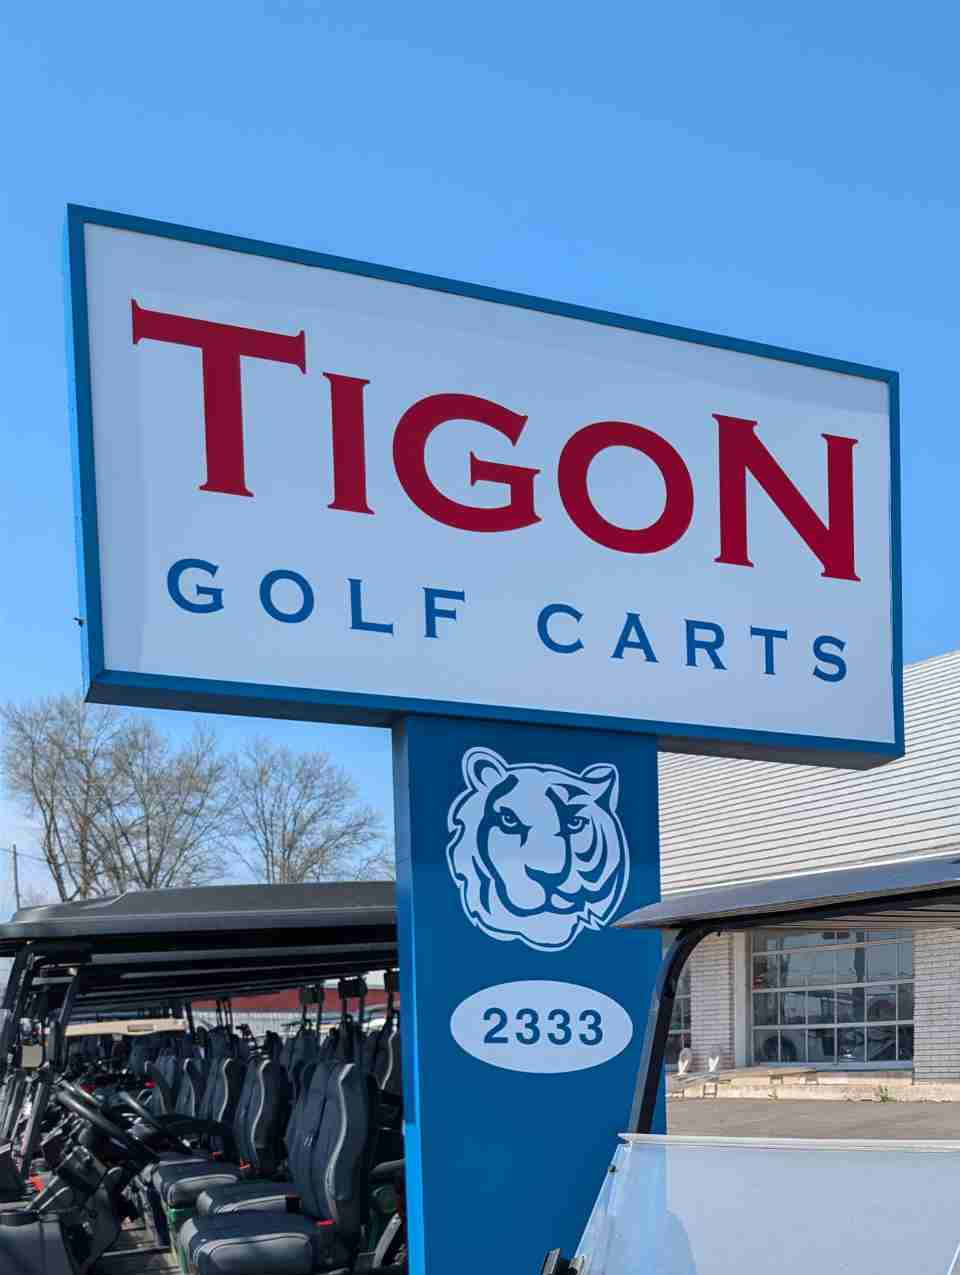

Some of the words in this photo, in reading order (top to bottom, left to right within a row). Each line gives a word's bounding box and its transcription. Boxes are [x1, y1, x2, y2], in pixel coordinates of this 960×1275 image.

[132, 299, 860, 581] TIGON
[166, 558, 466, 639] GOLF
[536, 603, 848, 683] CARTS
[482, 1007, 604, 1046] 2333
